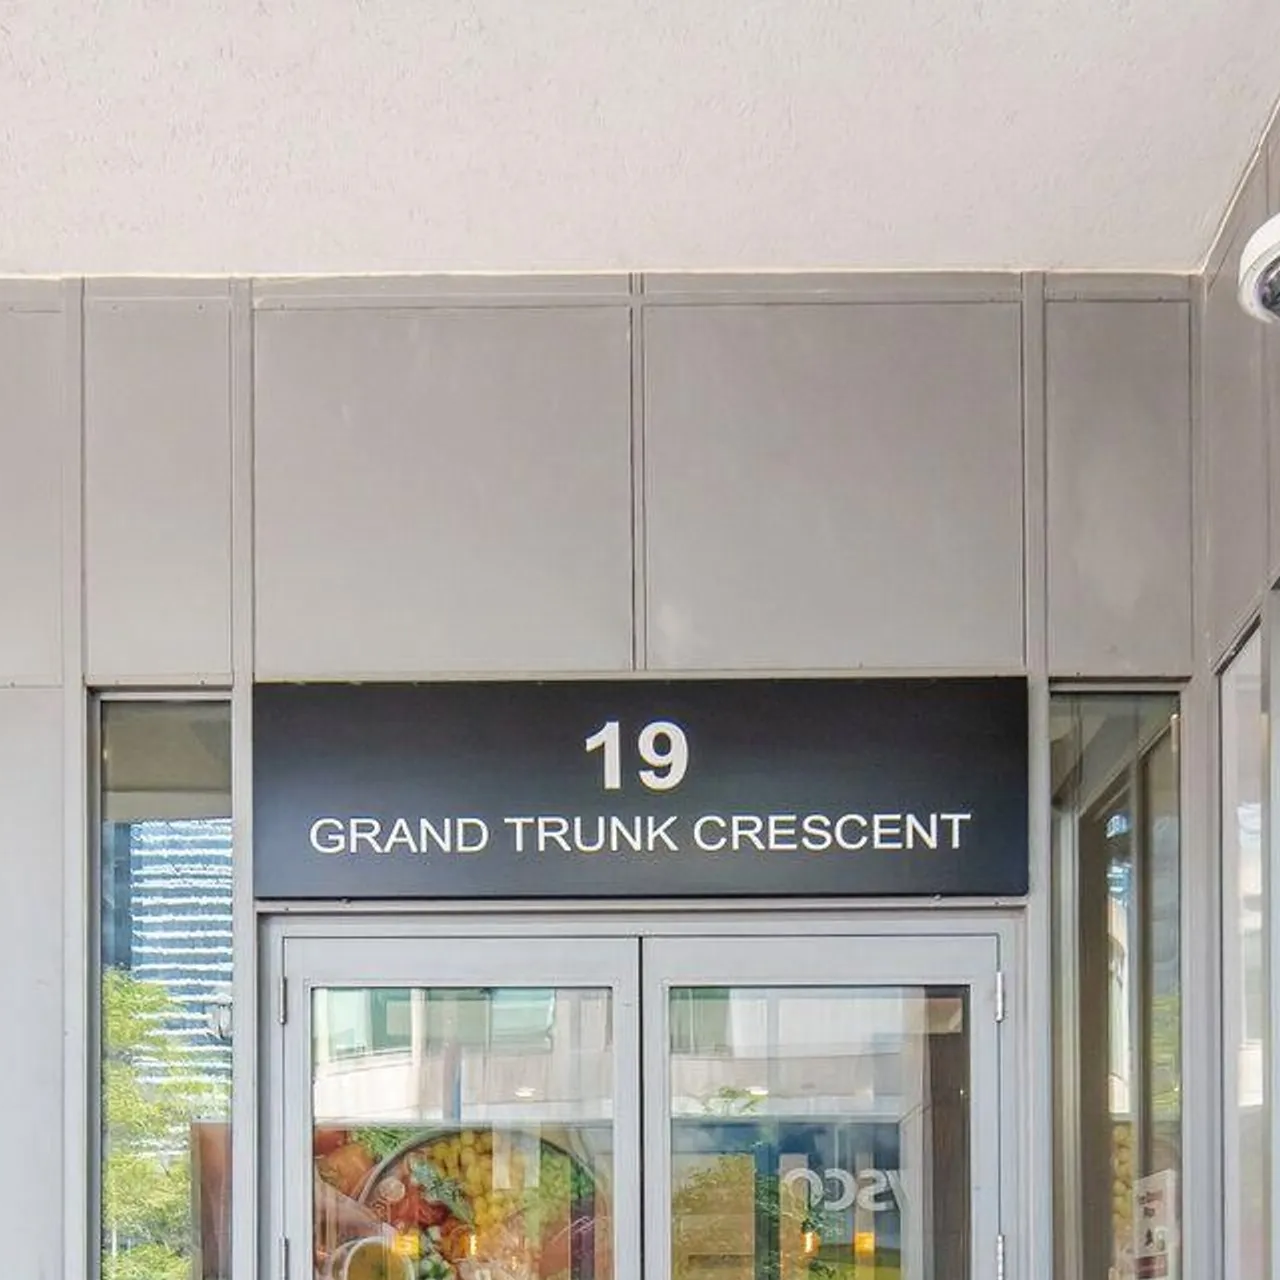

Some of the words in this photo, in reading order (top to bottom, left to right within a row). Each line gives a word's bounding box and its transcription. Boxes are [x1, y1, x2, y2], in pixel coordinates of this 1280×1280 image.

[584, 720, 690, 790] 19
[309, 816, 489, 853] GRAND
[503, 815, 679, 852] TRUNK
[692, 813, 972, 851] CRESCENT
